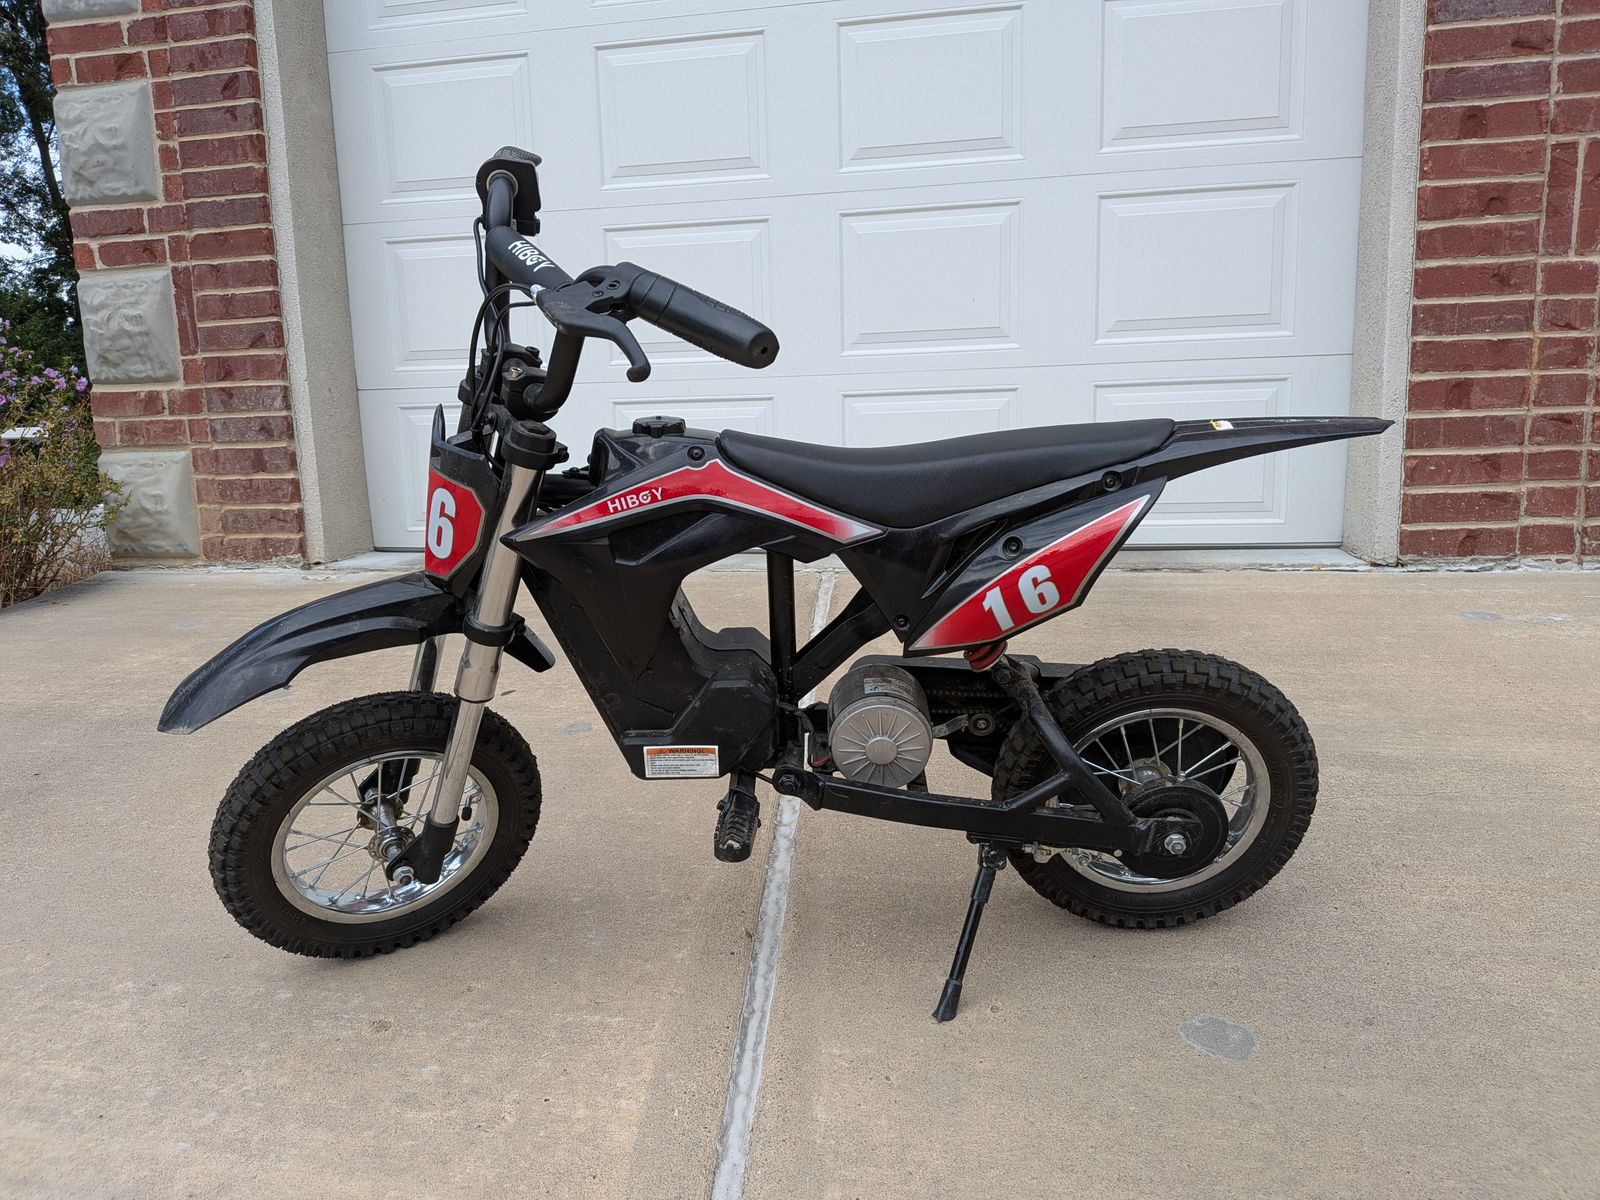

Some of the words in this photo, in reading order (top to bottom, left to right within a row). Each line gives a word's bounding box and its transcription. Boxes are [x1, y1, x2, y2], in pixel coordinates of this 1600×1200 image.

[508, 240, 555, 272] HIBOY
[428, 487, 456, 559] 6
[607, 486, 663, 513] HIBOY
[982, 564, 1060, 631] 16
